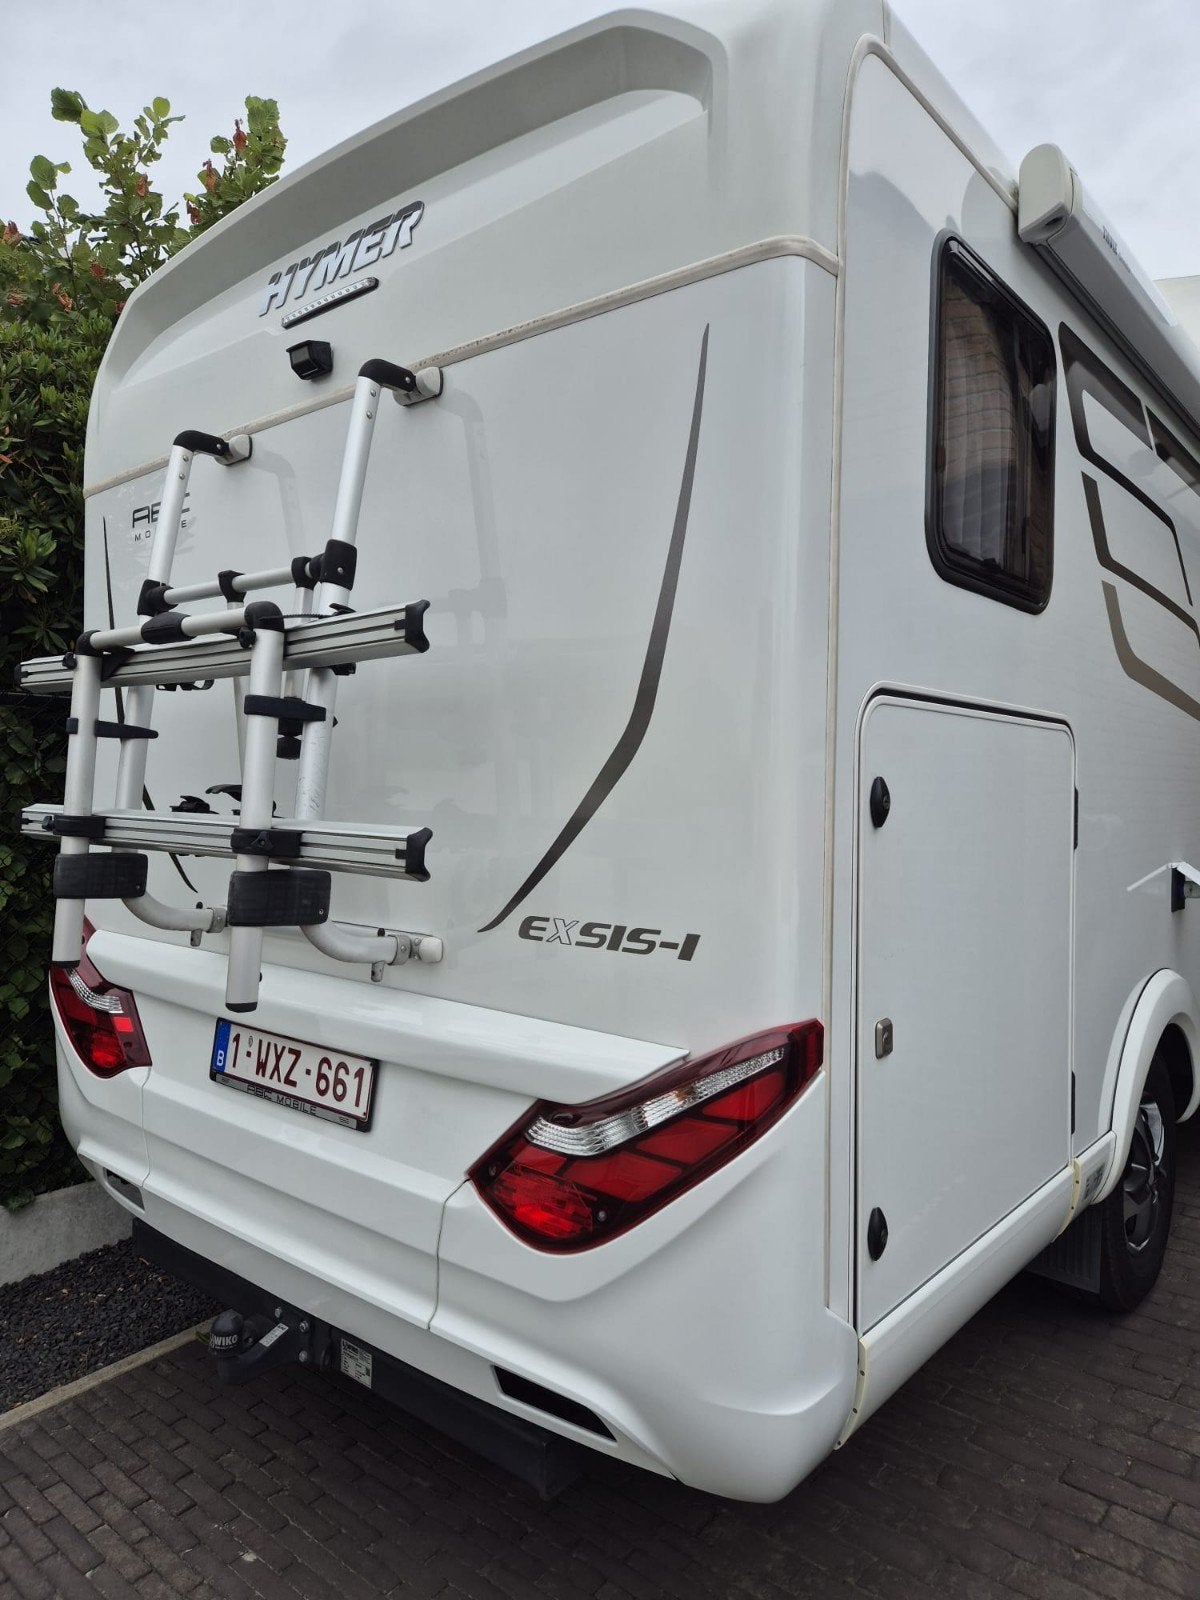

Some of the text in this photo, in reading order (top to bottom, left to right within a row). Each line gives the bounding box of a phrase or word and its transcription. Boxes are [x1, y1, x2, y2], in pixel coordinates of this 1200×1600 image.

[259, 200, 425, 318] HYMER
[134, 519, 187, 542] MOE
[518, 915, 701, 962] EXSIS-I
[216, 1050, 225, 1067] B
[232, 1032, 365, 1108] 1-WXZ-661
[276, 1094, 317, 1116] MOBILE
